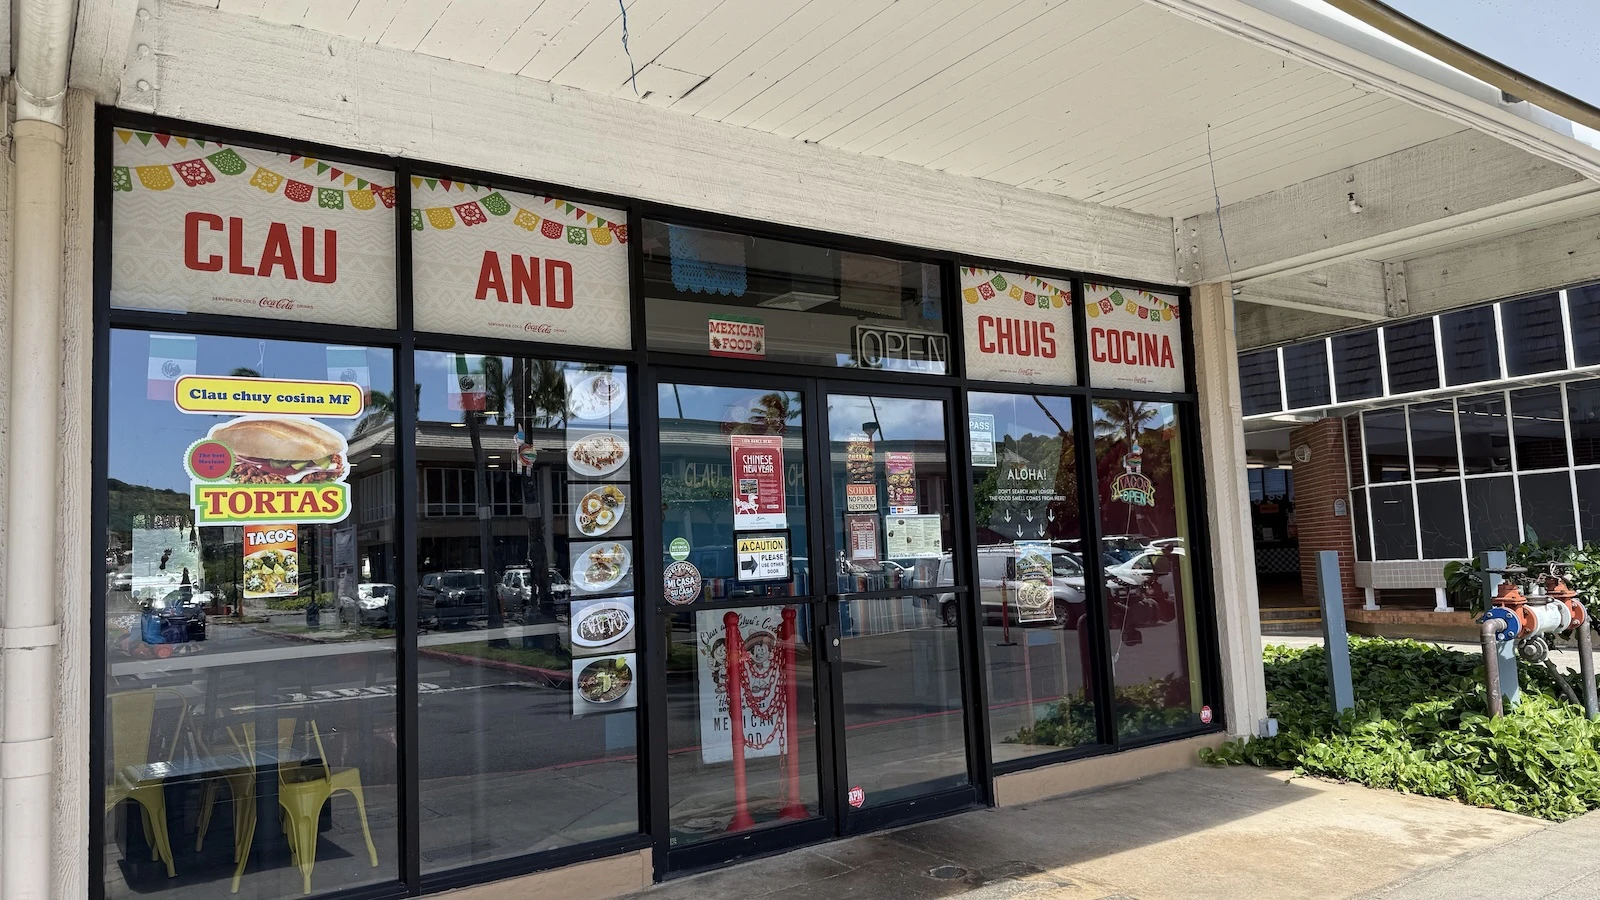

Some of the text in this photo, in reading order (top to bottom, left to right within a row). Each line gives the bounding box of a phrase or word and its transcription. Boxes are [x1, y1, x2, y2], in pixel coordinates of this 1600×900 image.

[184, 211, 337, 284] CLAU
[475, 250, 573, 309] AND
[709, 321, 764, 338] MEXICAN
[978, 315, 1057, 359] CHUIS
[722, 338, 753, 351] FOOD
[861, 329, 947, 371] OPEN
[1090, 327, 1175, 369] COCINA
[189, 388, 352, 405] Clau chuy cosina MF
[970, 421, 990, 430] PASS
[742, 455, 773, 465] CHINESE
[743, 464, 774, 473] NEW YEAR
[684, 462, 720, 488] CLAU
[1008, 468, 1047, 480] ALOHA!
[848, 486, 874, 495] SORRY
[1120, 475, 1150, 493] TACOS
[204, 490, 339, 515] TORTAS
[1123, 490, 1147, 506] OPEN
[246, 528, 296, 546] TACOS
[750, 540, 783, 551] CAUTION
[667, 565, 694, 578] WELCOME
[668, 577, 695, 588] MI CASA
[670, 587, 694, 597] SU CASA
[700, 627, 718, 645] Clau
[714, 714, 774, 731] MEICAN
[848, 789, 863, 801] APN
